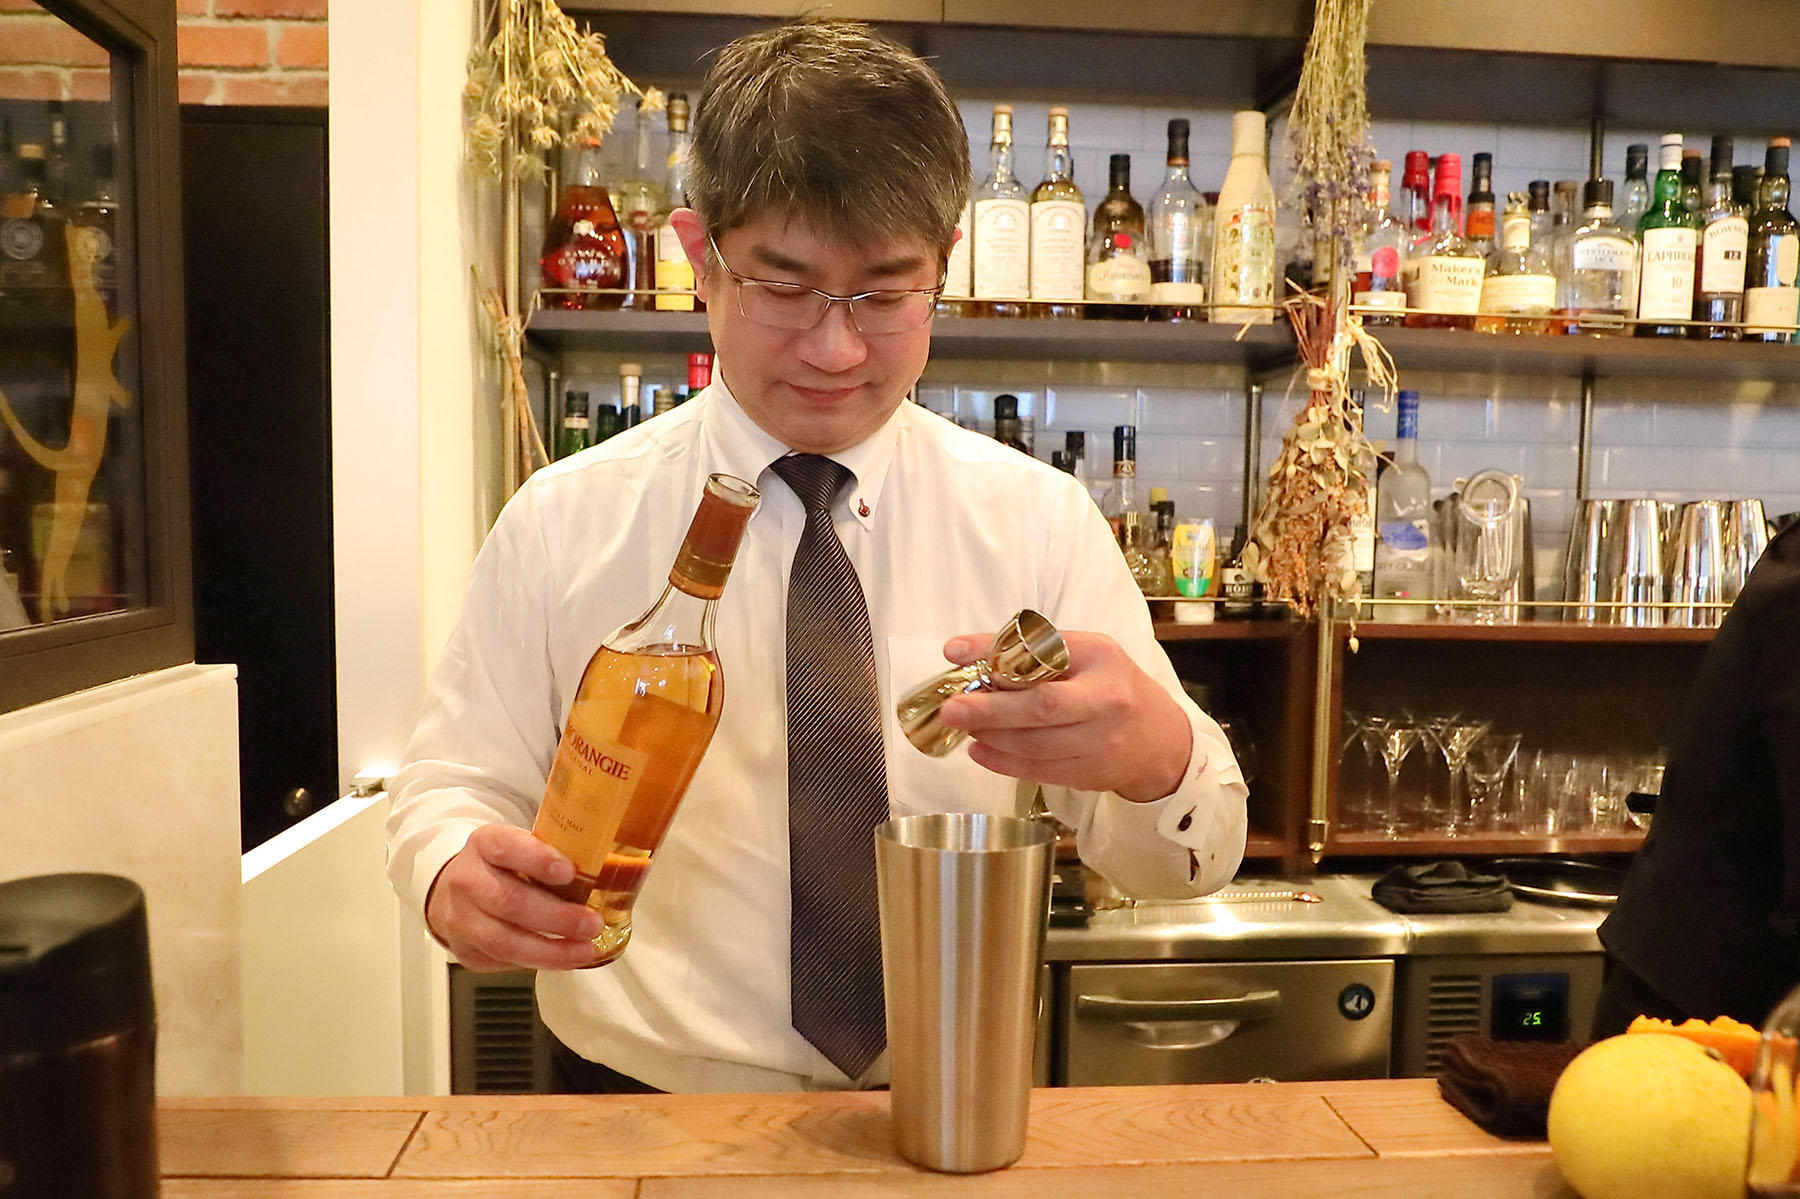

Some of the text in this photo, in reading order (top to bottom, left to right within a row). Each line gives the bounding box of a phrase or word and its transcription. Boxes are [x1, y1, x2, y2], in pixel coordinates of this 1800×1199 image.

[1446, 275, 1479, 287] Mark
[1671, 276, 1683, 288] 10
[1522, 1011, 1542, 1026] 25
